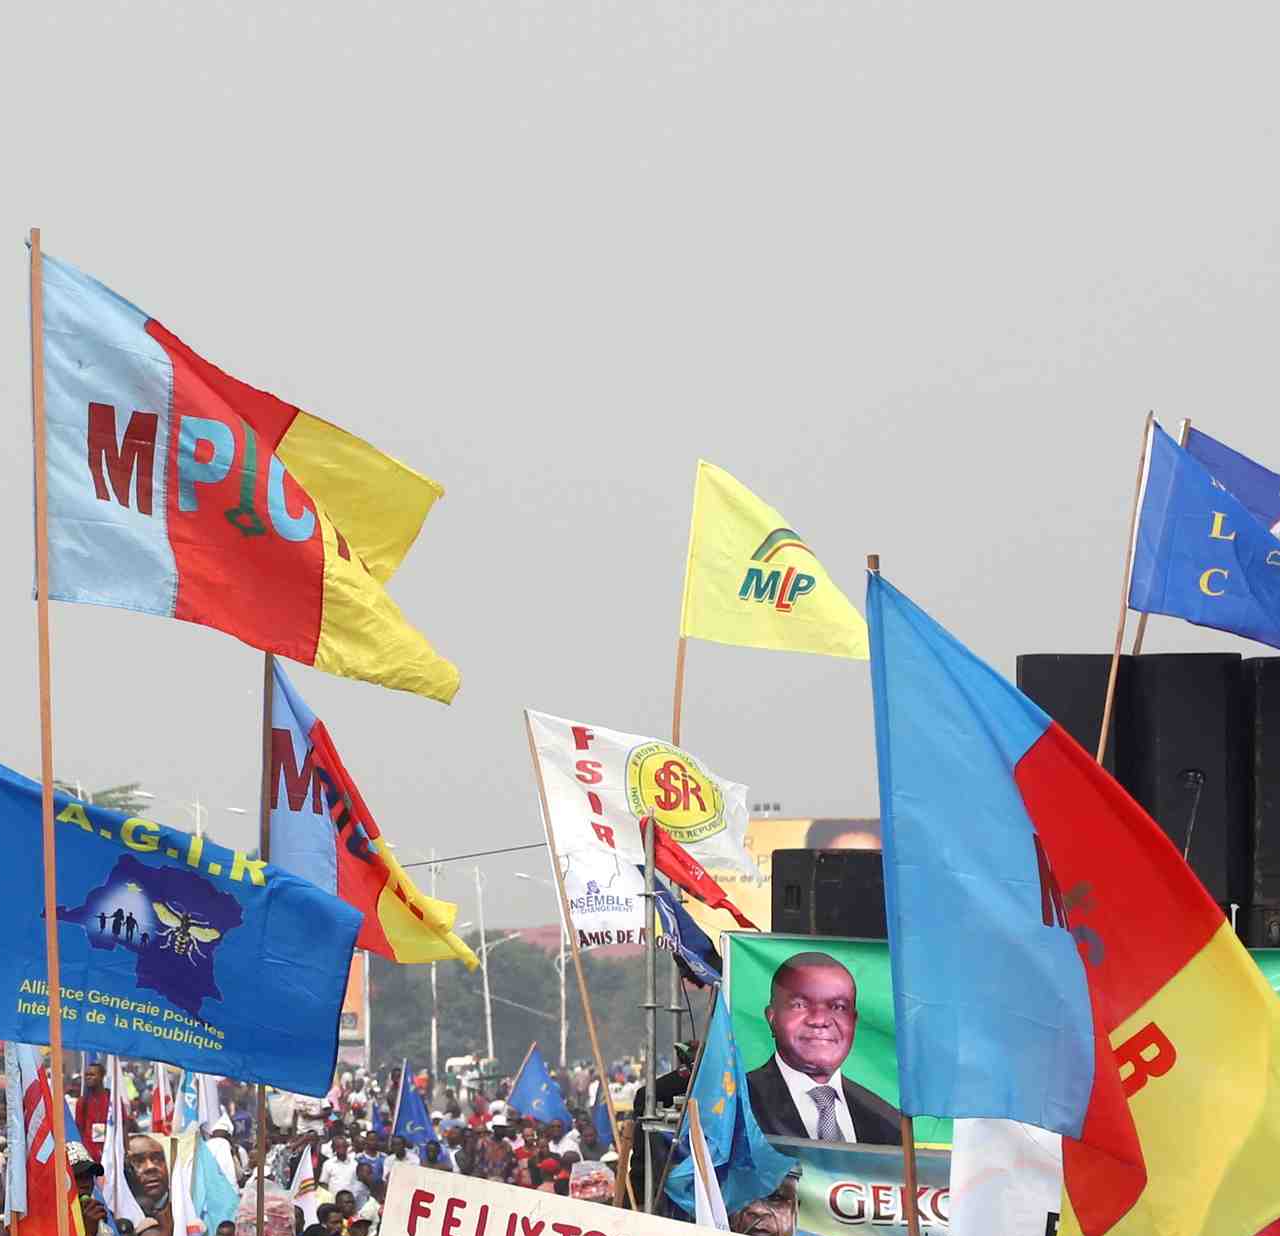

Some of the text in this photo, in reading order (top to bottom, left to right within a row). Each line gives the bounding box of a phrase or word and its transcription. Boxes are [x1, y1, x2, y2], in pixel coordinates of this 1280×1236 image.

[739, 567, 816, 612] MLP
[616, 930, 634, 945] DE
[86, 1009, 106, 1025] de
